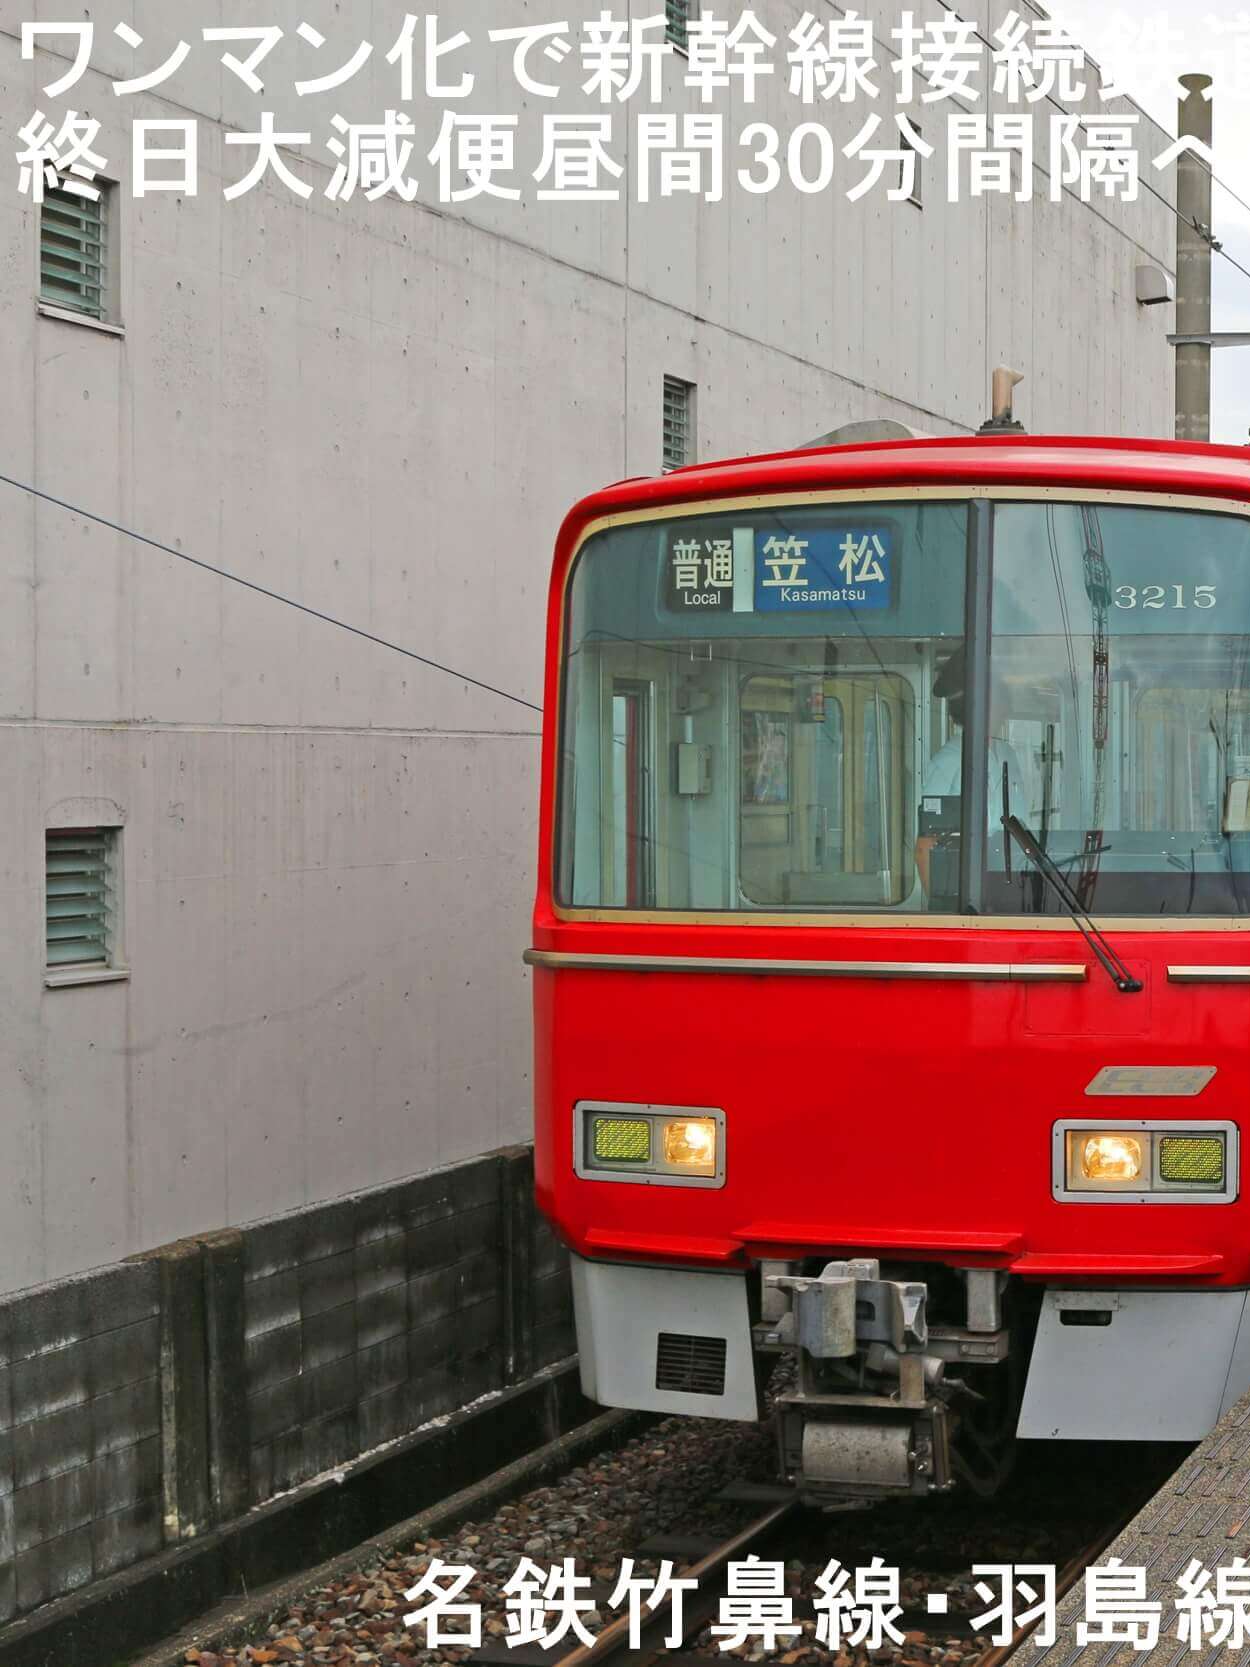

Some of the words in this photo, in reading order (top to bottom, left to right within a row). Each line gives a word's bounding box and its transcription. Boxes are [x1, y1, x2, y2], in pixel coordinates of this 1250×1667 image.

[672, 539, 734, 589] 普通
[762, 533, 886, 587] 笠松
[684, 591, 721, 605] Local
[781, 588, 866, 602] Kasamatsu
[1114, 584, 1217, 609] 3215
